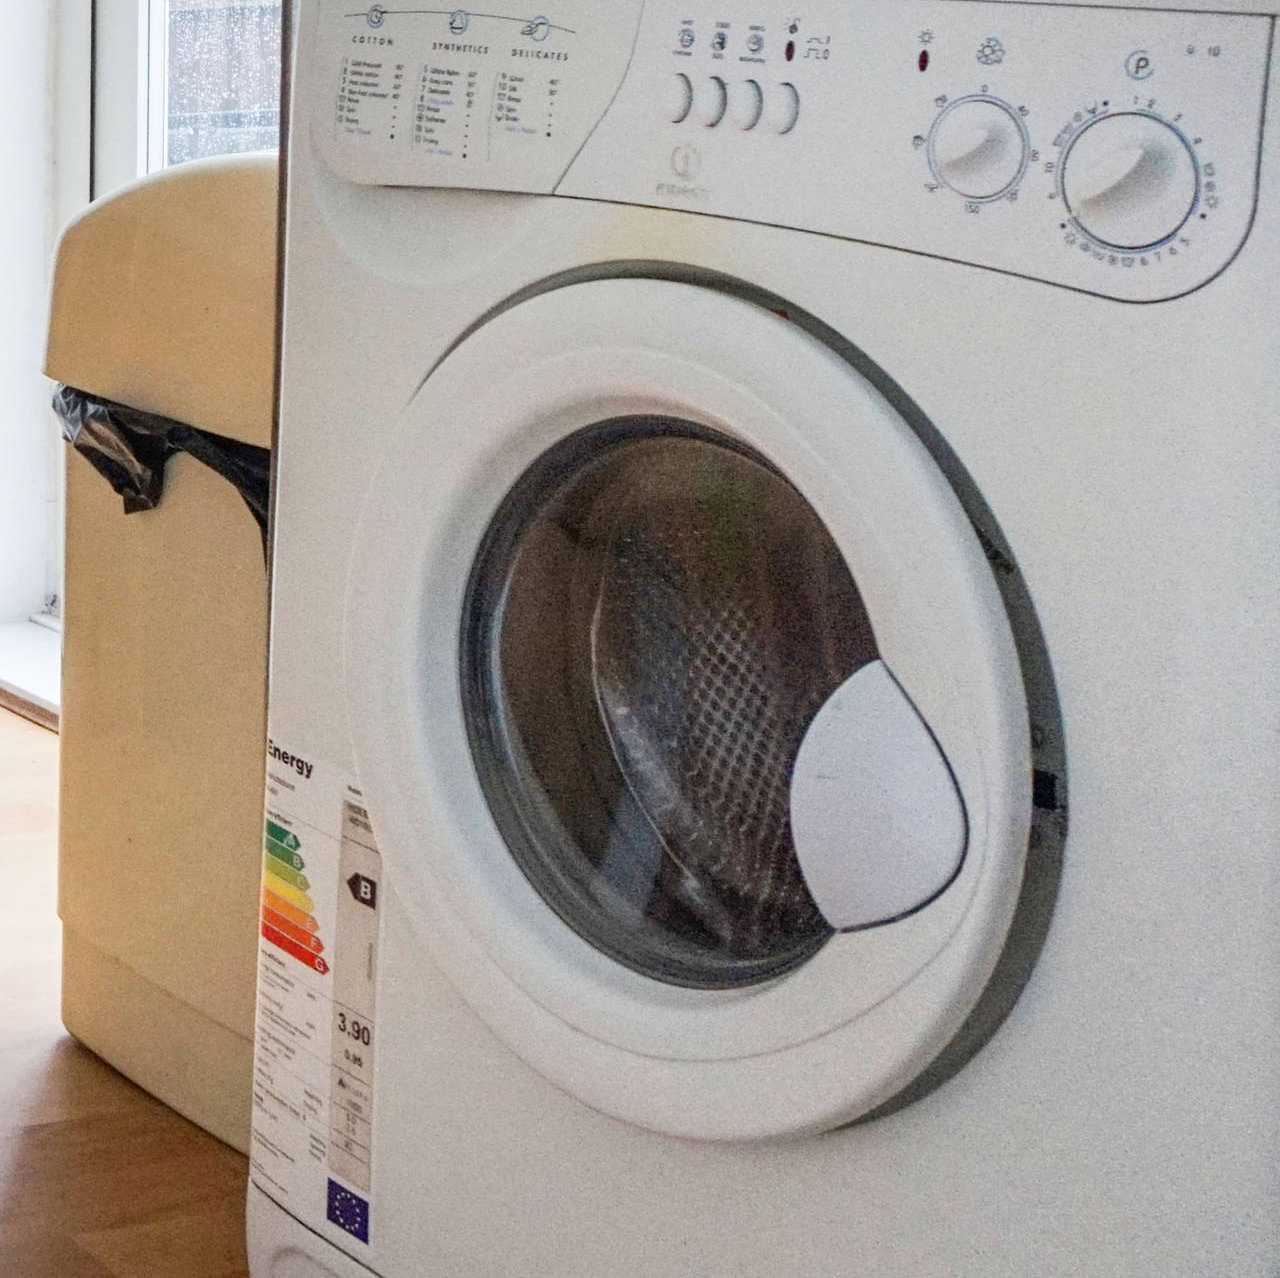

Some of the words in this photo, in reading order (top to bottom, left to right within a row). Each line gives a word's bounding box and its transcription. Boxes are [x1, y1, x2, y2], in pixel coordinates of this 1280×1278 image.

[352, 35, 394, 46] COTTON
[432, 42, 489, 54] SYNTHETICS
[511, 49, 569, 61] DELICATES
[360, 880, 371, 900] B
[338, 1012, 370, 1046] 3.90
